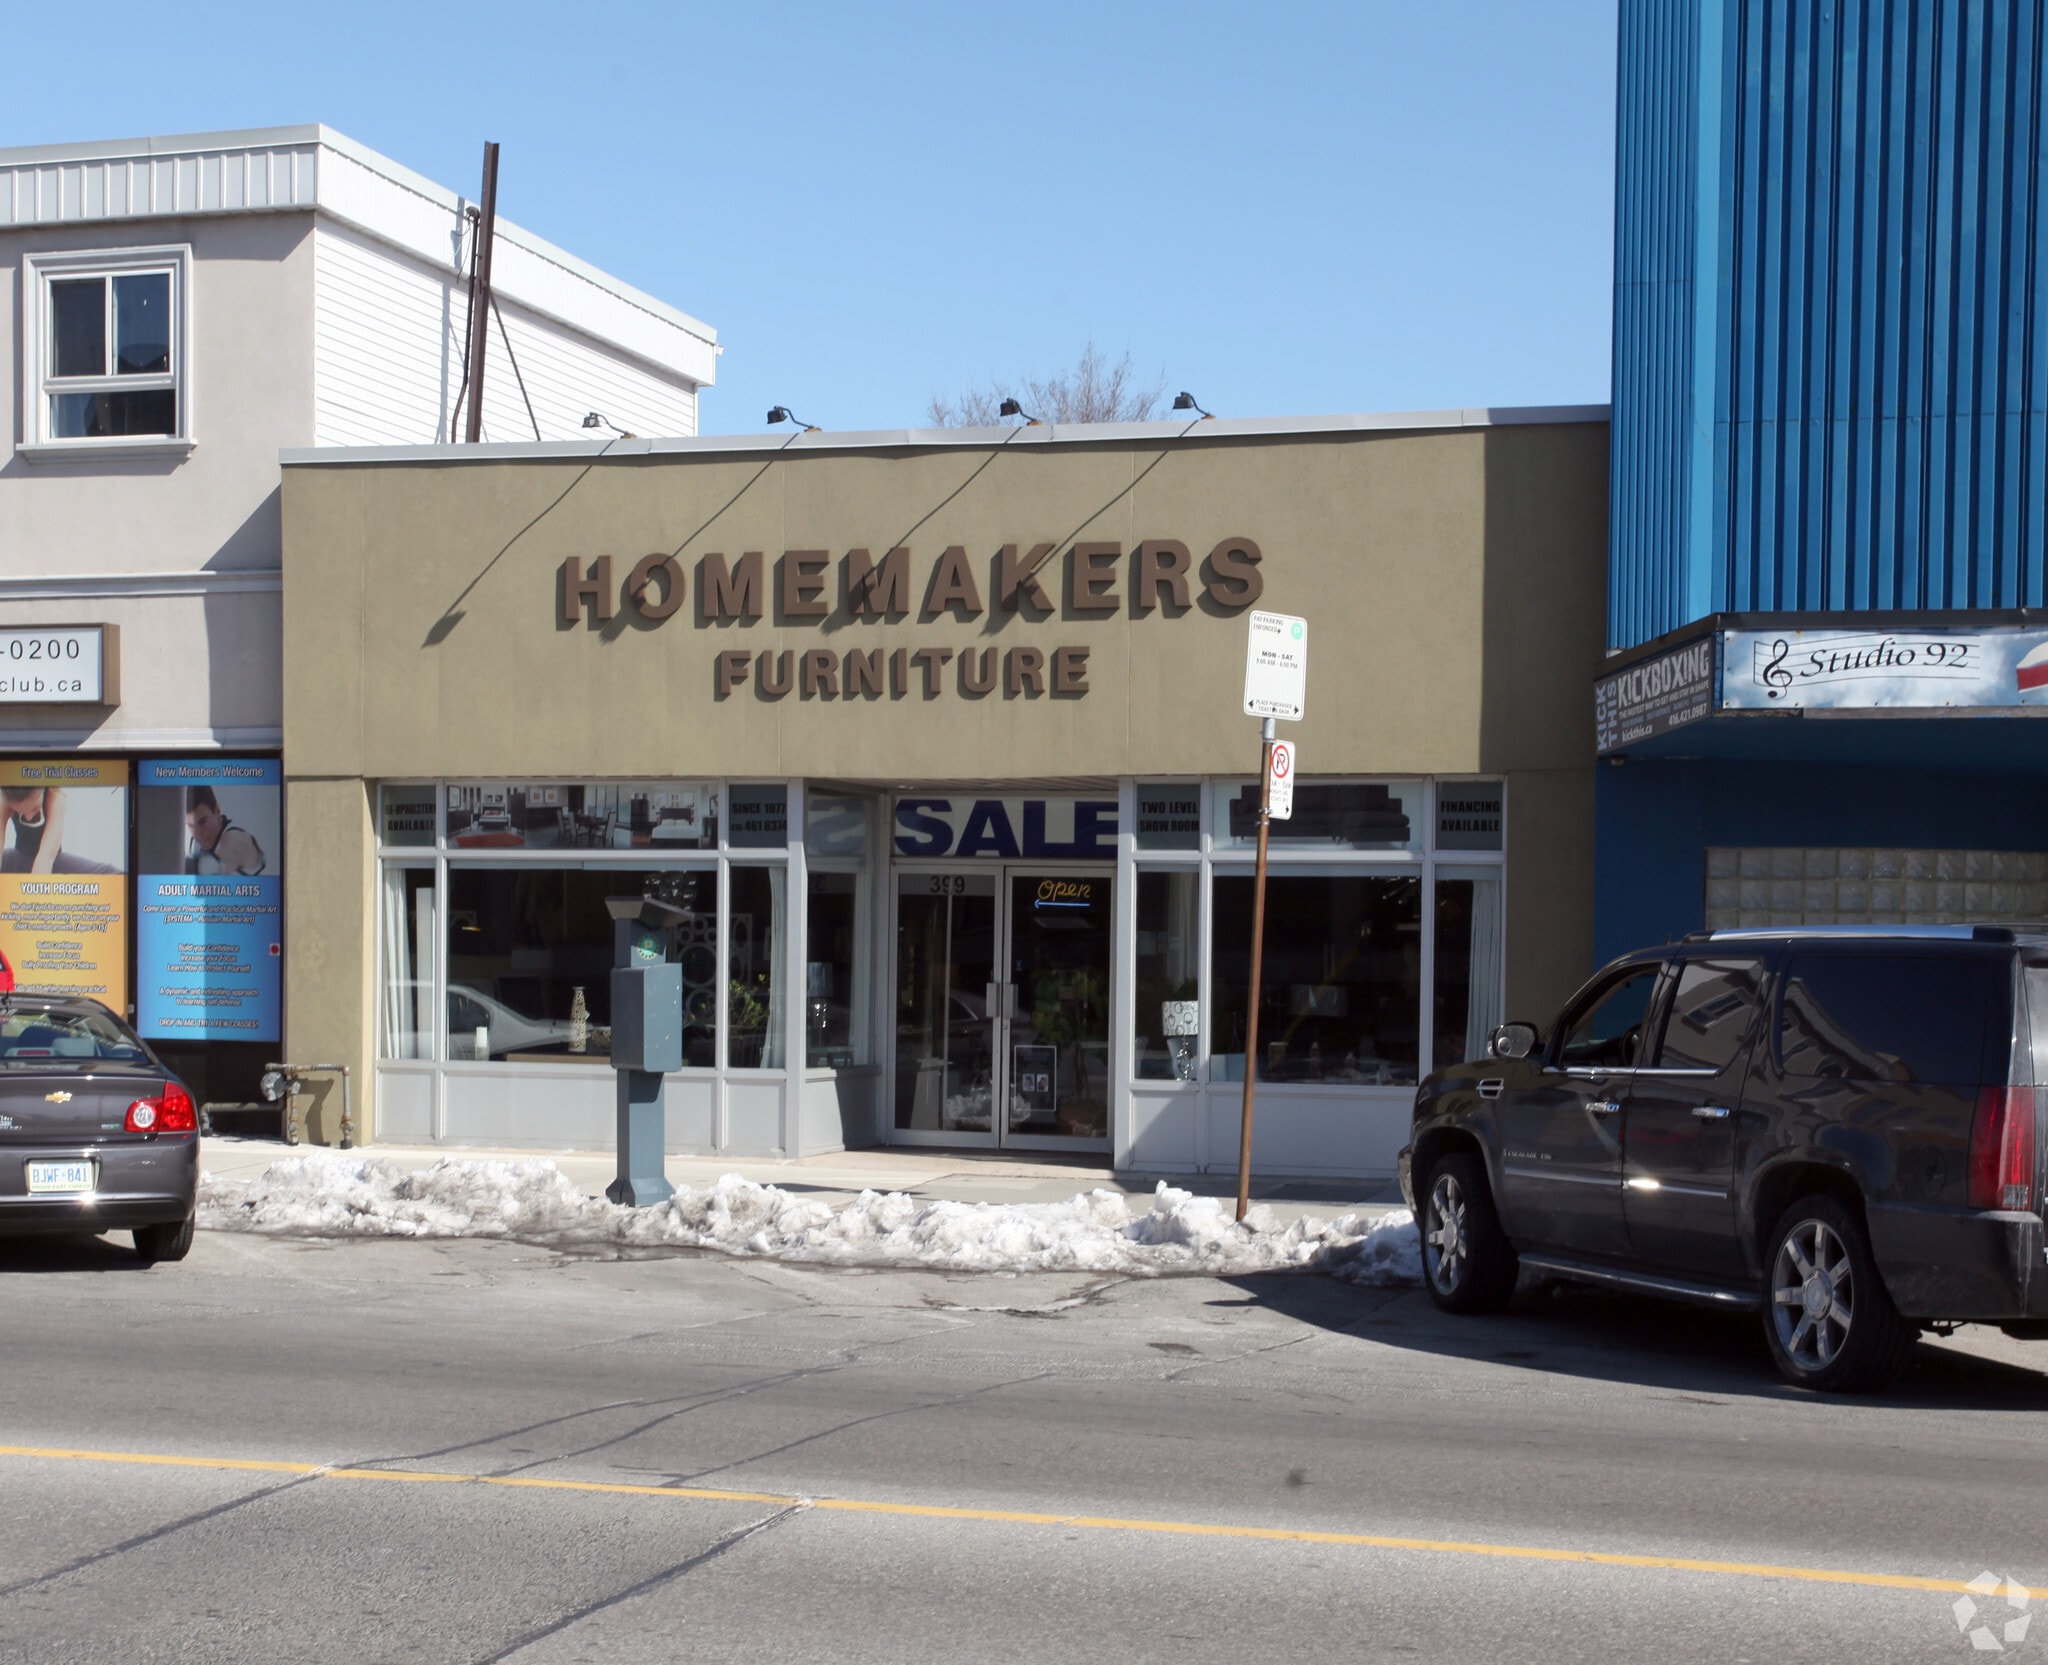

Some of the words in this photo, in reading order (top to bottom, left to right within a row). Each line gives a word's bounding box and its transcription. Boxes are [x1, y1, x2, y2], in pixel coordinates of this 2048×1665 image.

[560, 536, 1265, 622] HOMEMAKERS
[1262, 650, 1277, 659] MON
[1282, 653, 1294, 662] SAT
[1800, 637, 1916, 678] Studio
[1922, 642, 1969, 668] 92
[718, 645, 1091, 696] FURNITURE
[0, 677, 82, 692] club.ca
[1596, 683, 1607, 751] KICK
[1607, 680, 1618, 748] THIS
[22, 767, 42, 778] Free
[43, 767, 63, 778] Trial
[64, 767, 99, 778] Classes
[156, 766, 176, 777] New
[178, 766, 220, 777] Members
[222, 767, 264, 778] Welcome
[732, 802, 762, 814] SINCE
[764, 802, 786, 814] 1977
[1140, 801, 1166, 814] TWO
[1169, 801, 1198, 814] LEVEL
[1440, 800, 1501, 813] FINANCING
[387, 820, 436, 832] AVAILABLE
[893, 799, 1119, 859] SALE
[1139, 819, 1169, 833] SHOW
[1170, 819, 1200, 833] ROOM
[1440, 819, 1500, 832] AVAILABLE
[21, 883, 51, 895] YOUTH
[53, 883, 99, 896] PROGRAM
[158, 885, 188, 896] ADULT
[190, 885, 232, 897] MARTIAL
[235, 885, 261, 897] ARTS
[929, 875, 966, 895] 399
[1037, 879, 1091, 902] Open
[246, 905, 266, 913] Martial
[267, 904, 278, 913] Art
[51, 941, 83, 950] Confidence
[206, 943, 240, 952] Confidence
[74, 960, 97, 970] Children
[167, 963, 183, 972] Learn
[227, 963, 251, 973] Yourself
[32, 1167, 60, 1184] BJWF
[67, 1167, 88, 1183] 841
